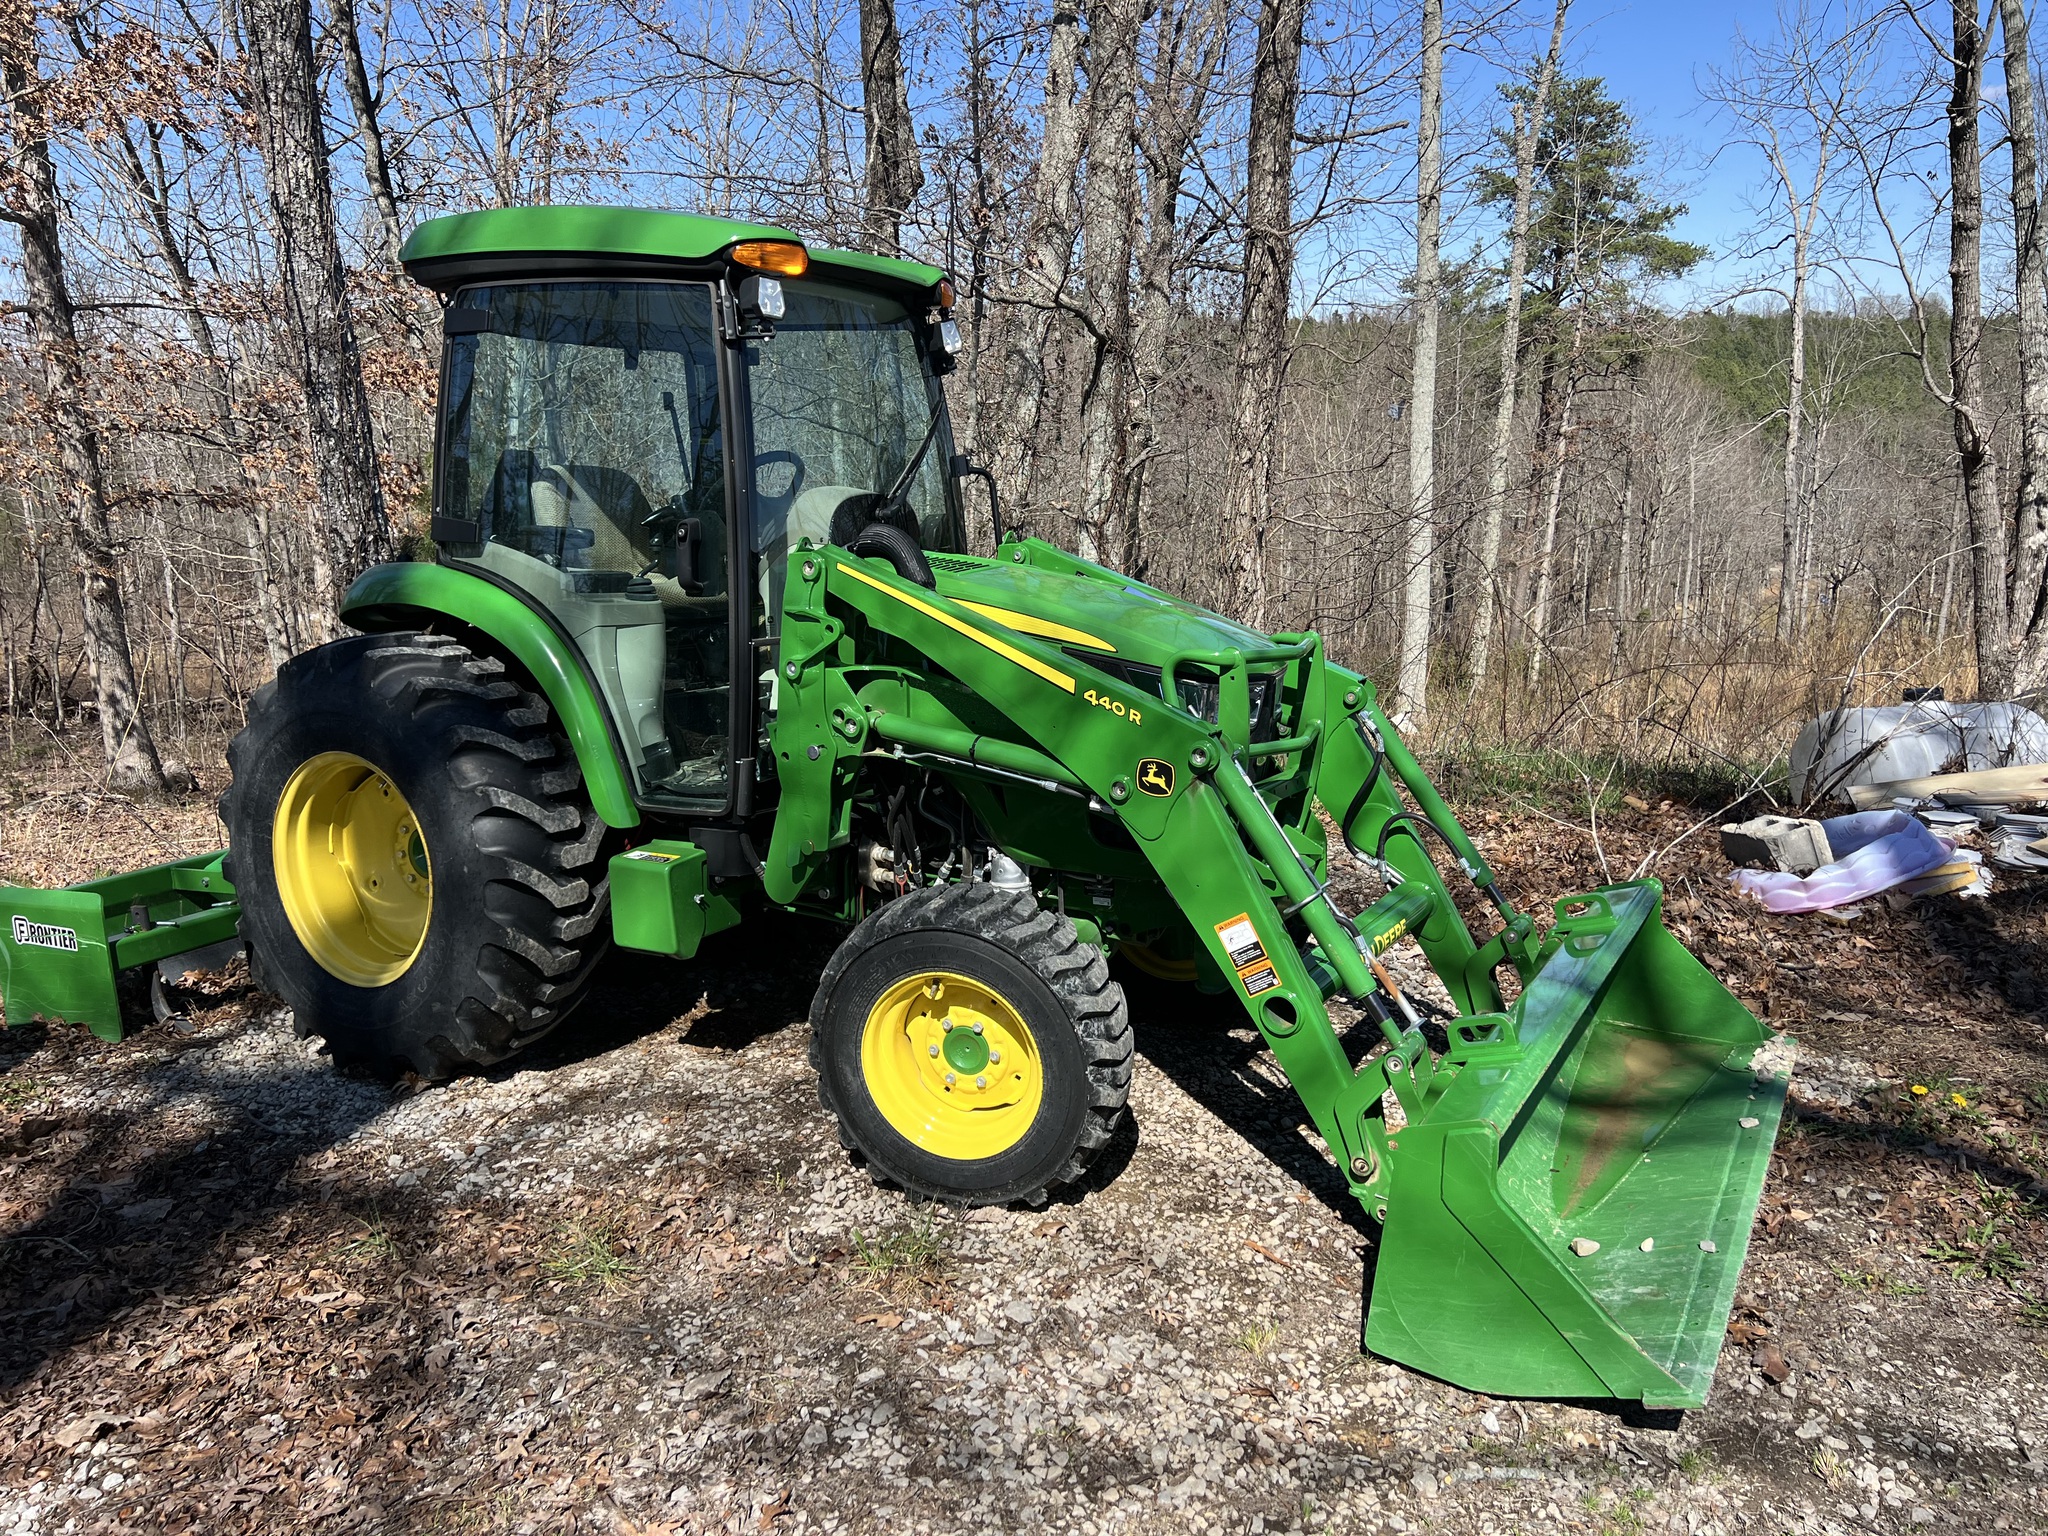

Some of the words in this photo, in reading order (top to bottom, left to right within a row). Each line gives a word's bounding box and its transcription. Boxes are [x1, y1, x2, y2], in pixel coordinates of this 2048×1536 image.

[1083, 689, 1126, 717] 440
[1128, 708, 1142, 727] R
[13, 917, 77, 950] FRONTIER
[1373, 918, 1407, 955] DEERE
